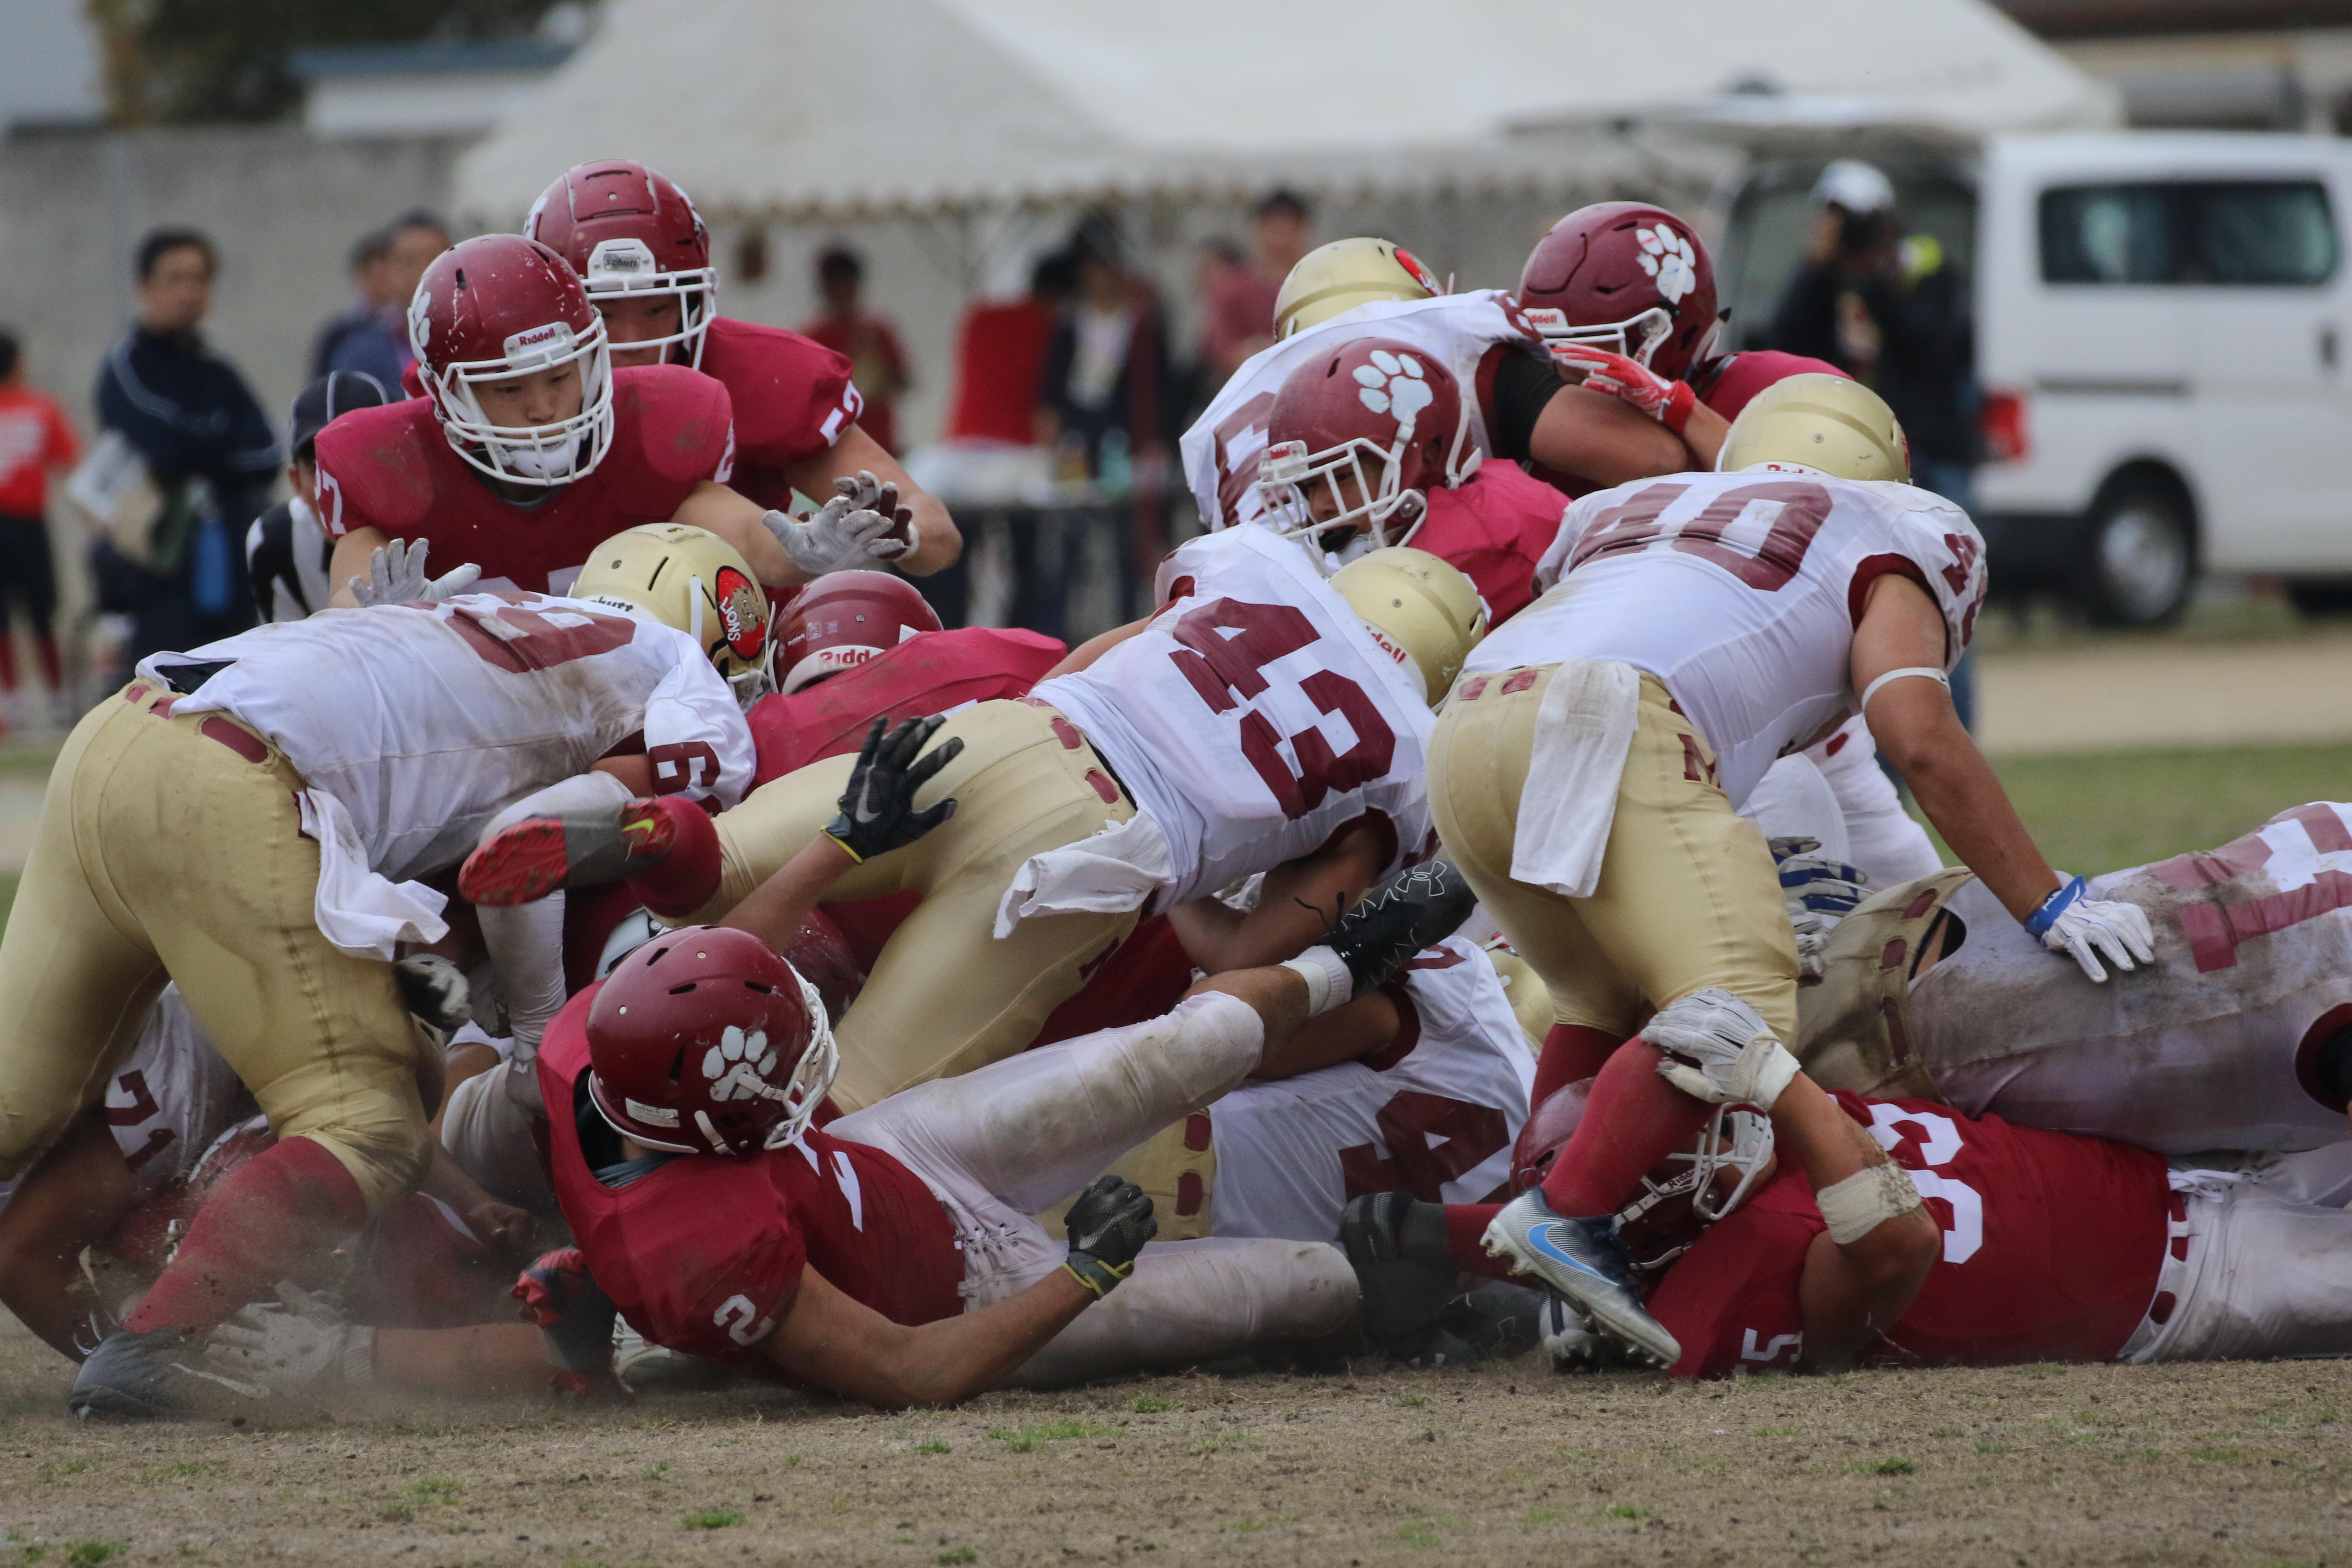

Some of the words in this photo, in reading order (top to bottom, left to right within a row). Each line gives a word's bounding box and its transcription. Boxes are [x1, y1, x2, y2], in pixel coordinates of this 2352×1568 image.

[519, 327, 555, 346] Riddell
[1568, 481, 1833, 592] 40
[719, 596, 741, 641] LIONS
[819, 649, 870, 667] Ridd
[1168, 596, 1396, 822] 43
[1338, 1089, 1511, 1204] 4
[712, 1294, 777, 1348] 2
